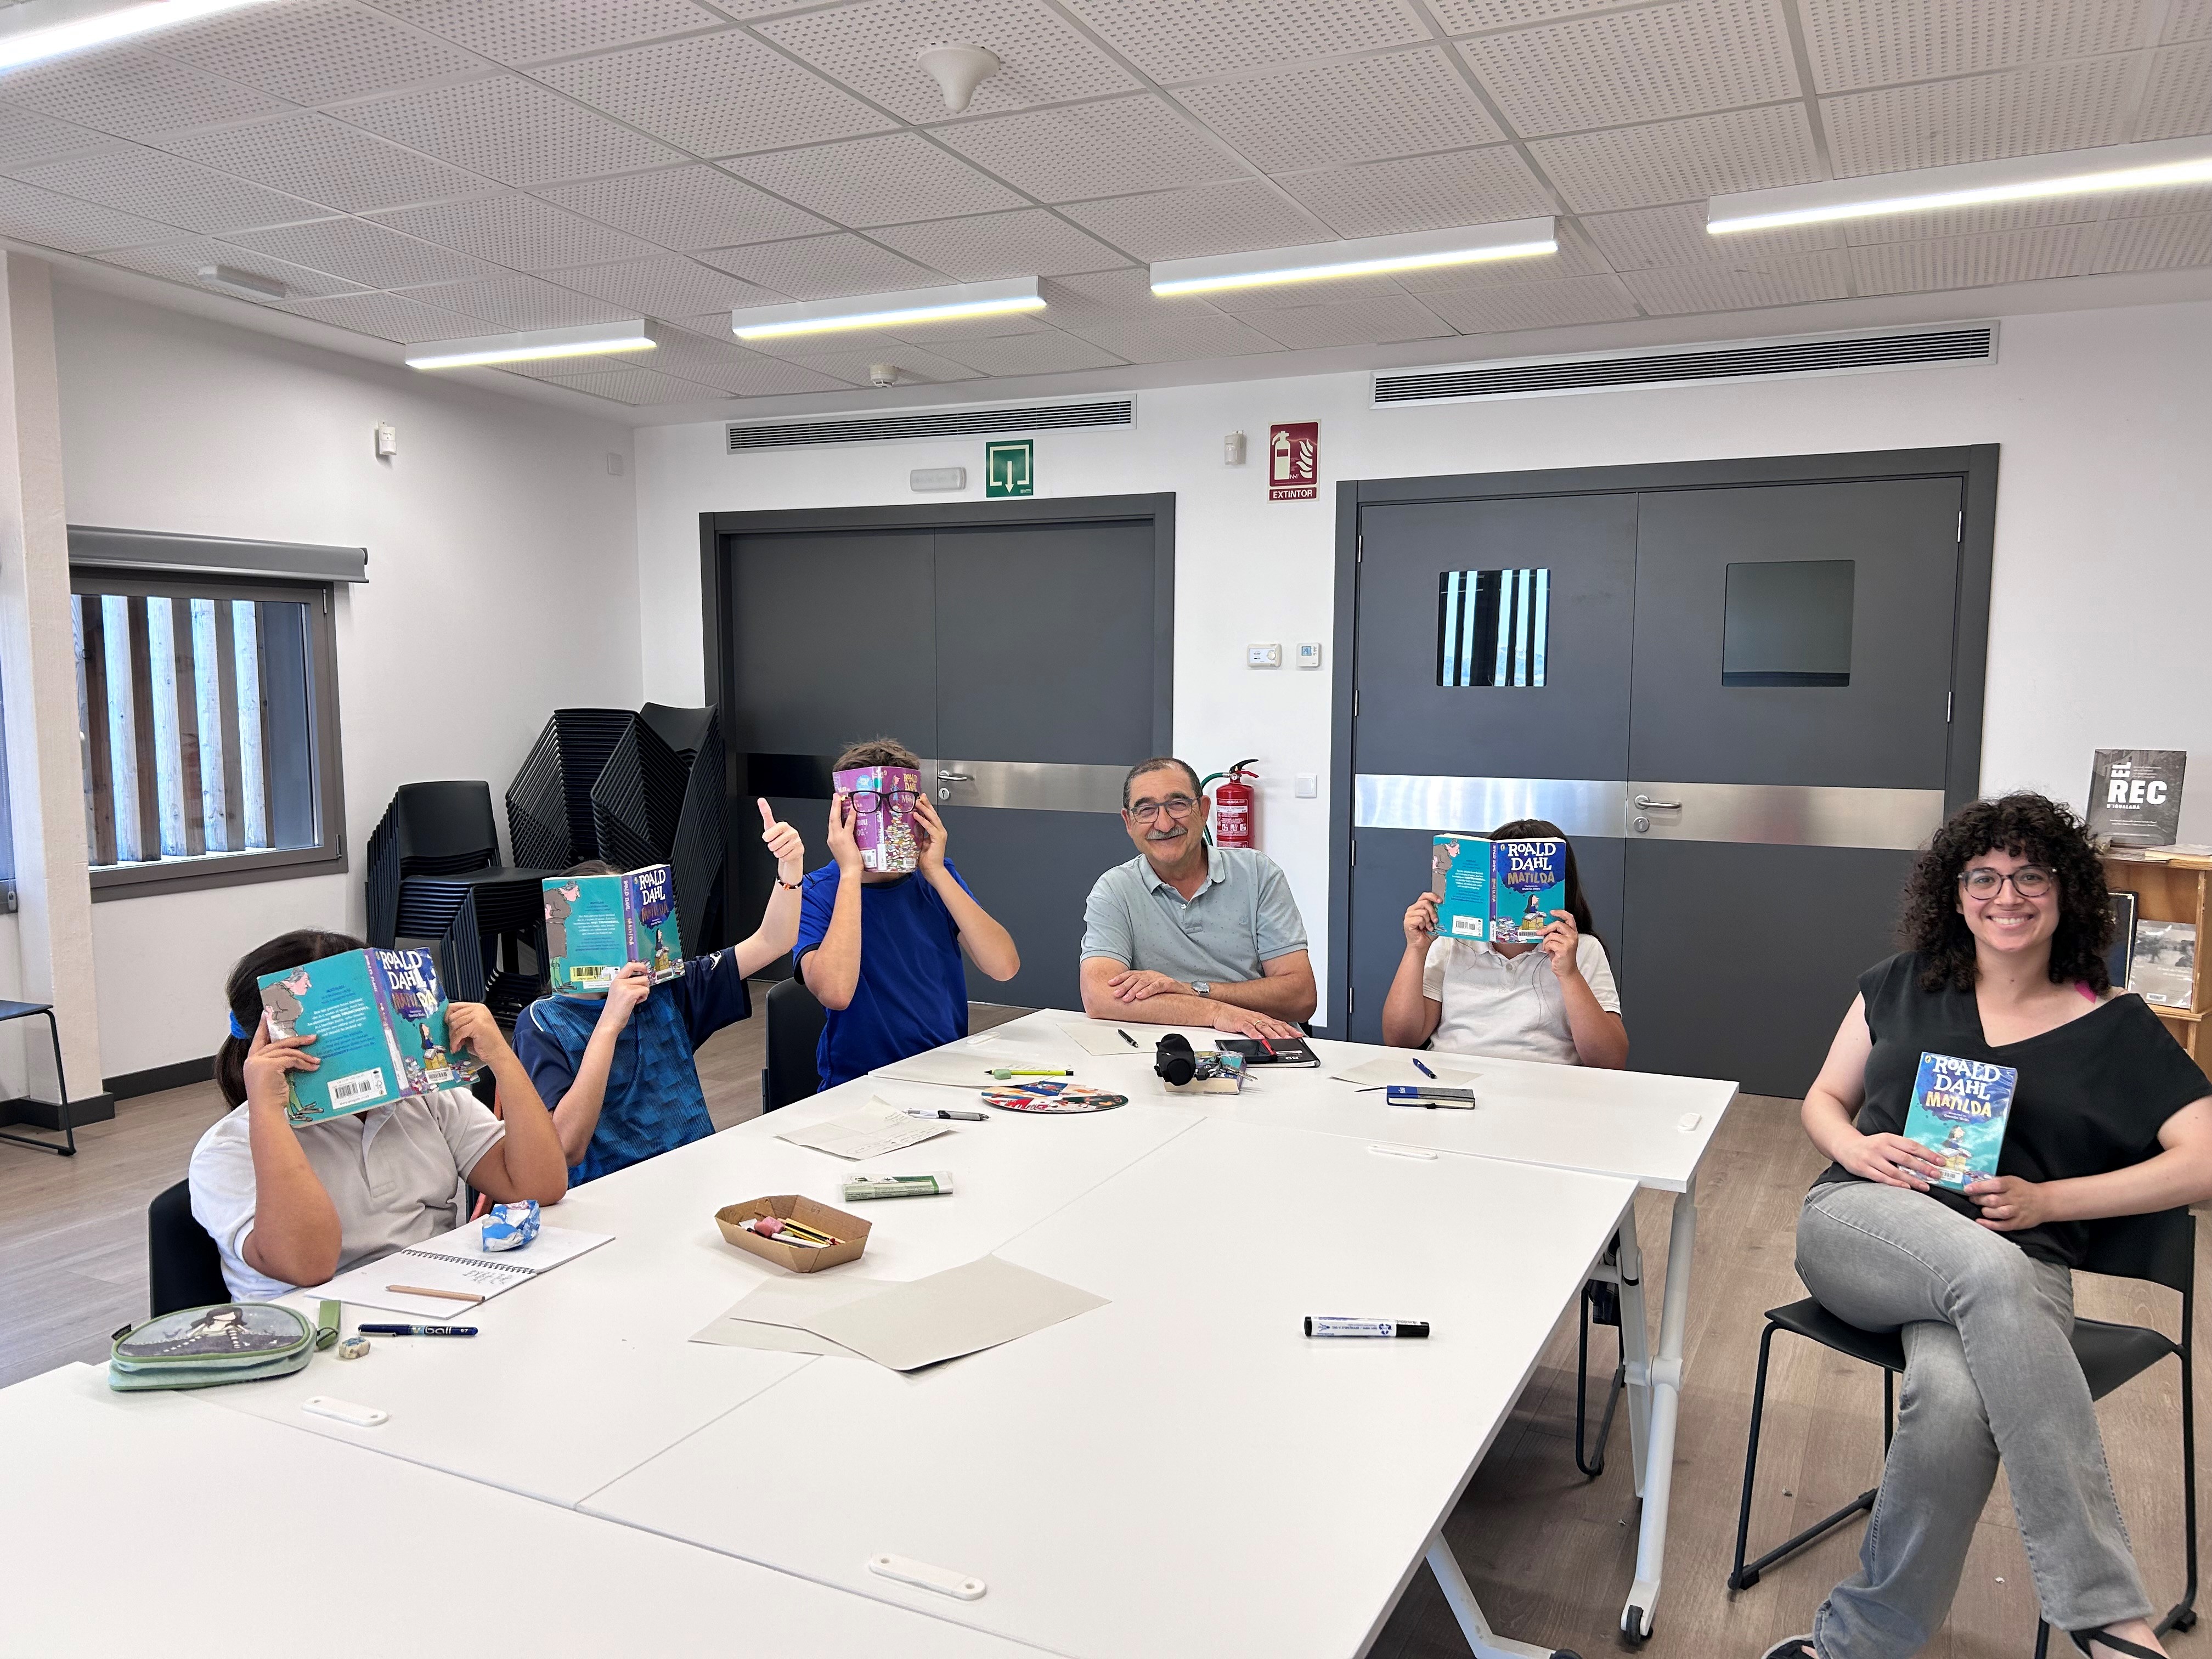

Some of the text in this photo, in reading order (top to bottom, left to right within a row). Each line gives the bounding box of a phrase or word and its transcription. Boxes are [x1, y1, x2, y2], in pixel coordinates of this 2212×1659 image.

[1273, 489, 1313, 499] EXTINTOR
[903, 773, 918, 783] ROALD
[2111, 762, 2131, 778] EL
[2108, 780, 2167, 805] REC
[1508, 843, 1556, 857] ROALD
[1511, 857, 1552, 871] DAHL
[639, 869, 666, 890] ROALD
[1507, 871, 1555, 885] MATILDA
[642, 885, 665, 905] DAHL
[379, 951, 422, 970] ROALD
[387, 968, 427, 990] DAHL
[1932, 1056, 2001, 1082] ROALD
[1934, 1074, 1991, 1101] DAHL
[1926, 1091, 1991, 1118] MATILDA
